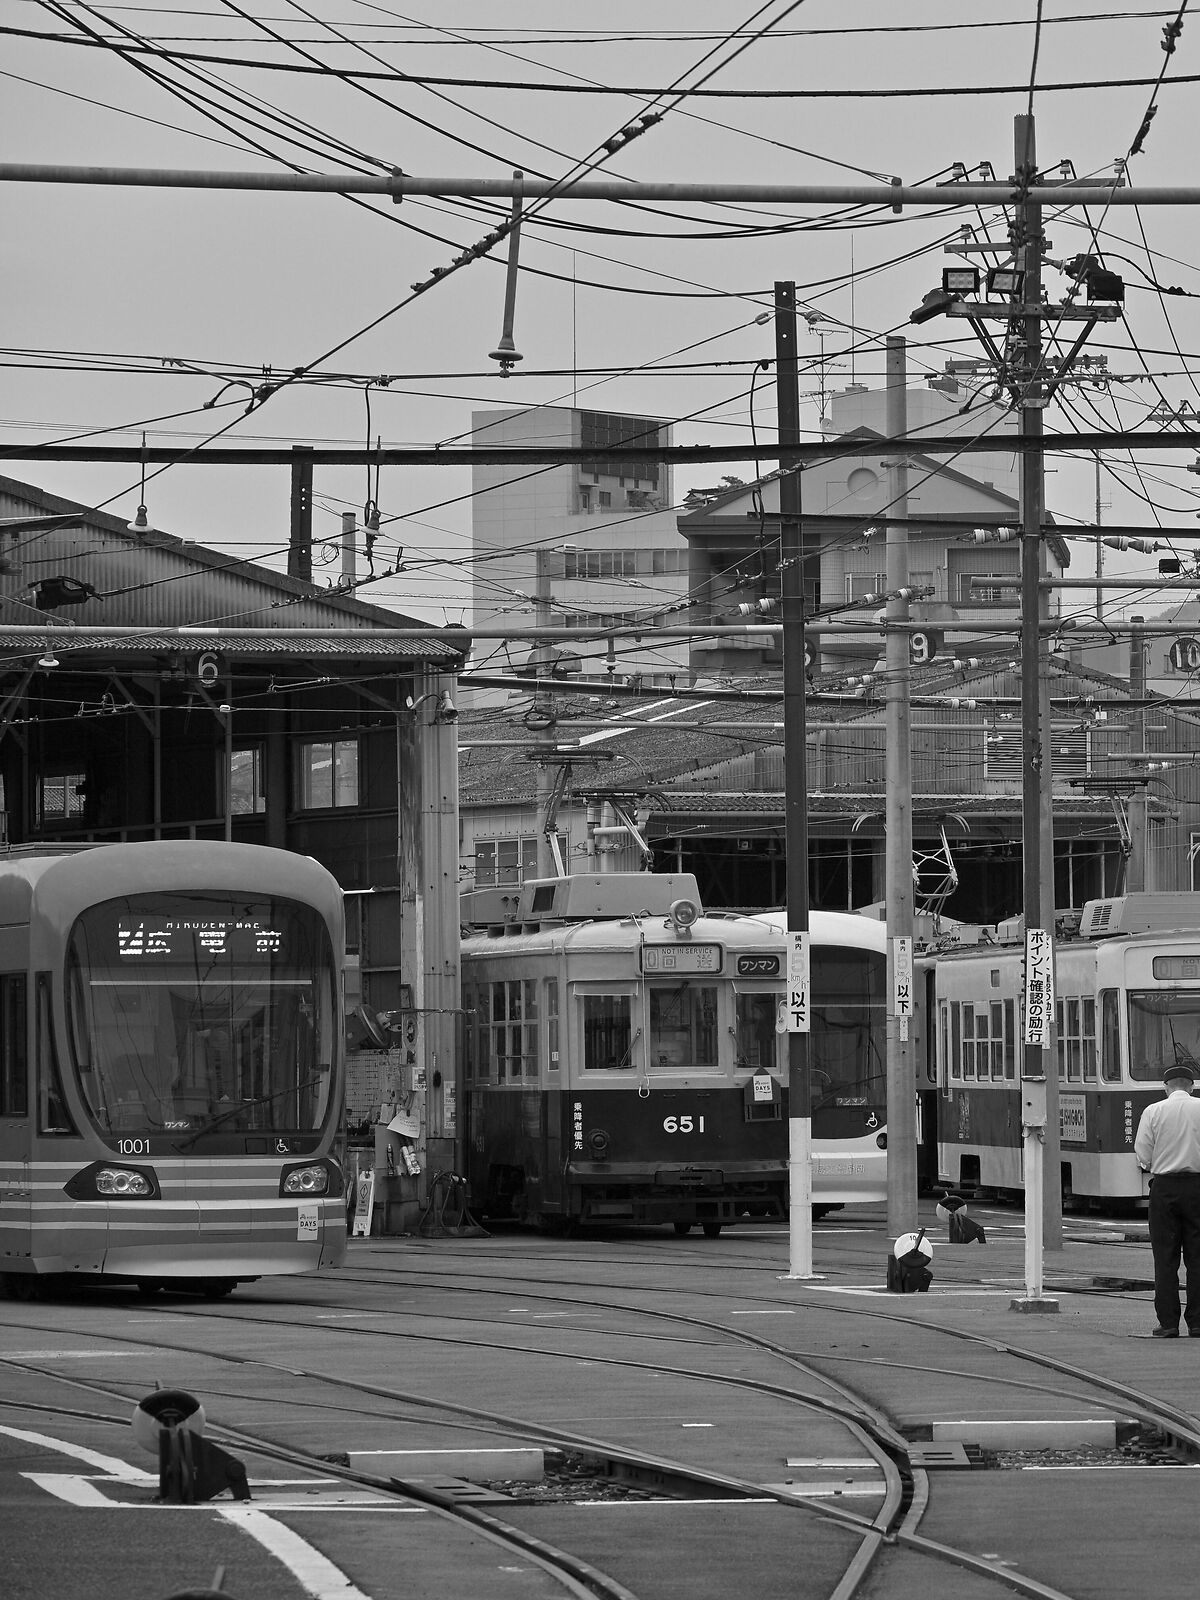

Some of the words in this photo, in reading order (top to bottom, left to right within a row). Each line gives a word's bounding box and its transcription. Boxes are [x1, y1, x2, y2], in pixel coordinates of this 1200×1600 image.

[911, 632, 929, 663] 9
[1175, 642, 1200, 668] 10
[198, 651, 219, 689] 6
[740, 960, 776, 971] ワンマン
[897, 984, 909, 1014] 以下
[1028, 931, 1044, 1042] ポイント確認の励行
[790, 991, 806, 1028] 以下
[164, 1121, 190, 1129] ワンマン
[573, 1102, 583, 1150] 乗降者優先
[662, 1115, 705, 1133] 651
[117, 1138, 150, 1154] 1001
